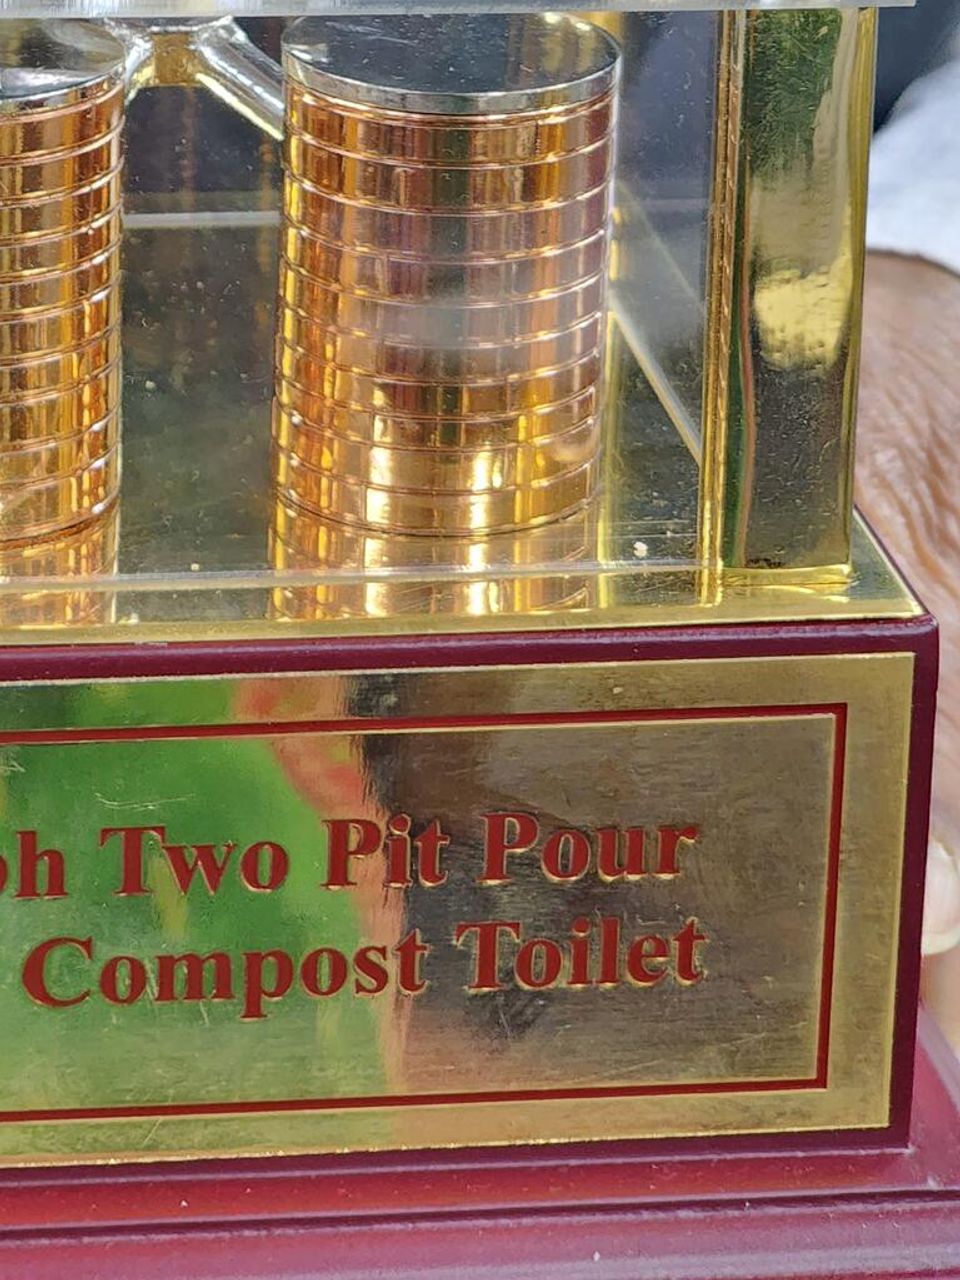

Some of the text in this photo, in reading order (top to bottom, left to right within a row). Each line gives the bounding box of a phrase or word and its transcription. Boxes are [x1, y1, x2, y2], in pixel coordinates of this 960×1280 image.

[99, 826, 290, 896] Two
[321, 813, 450, 889] Pit
[477, 811, 700, 885] Pour
[21, 927, 431, 1020] Compost
[454, 916, 708, 994] Toilet
